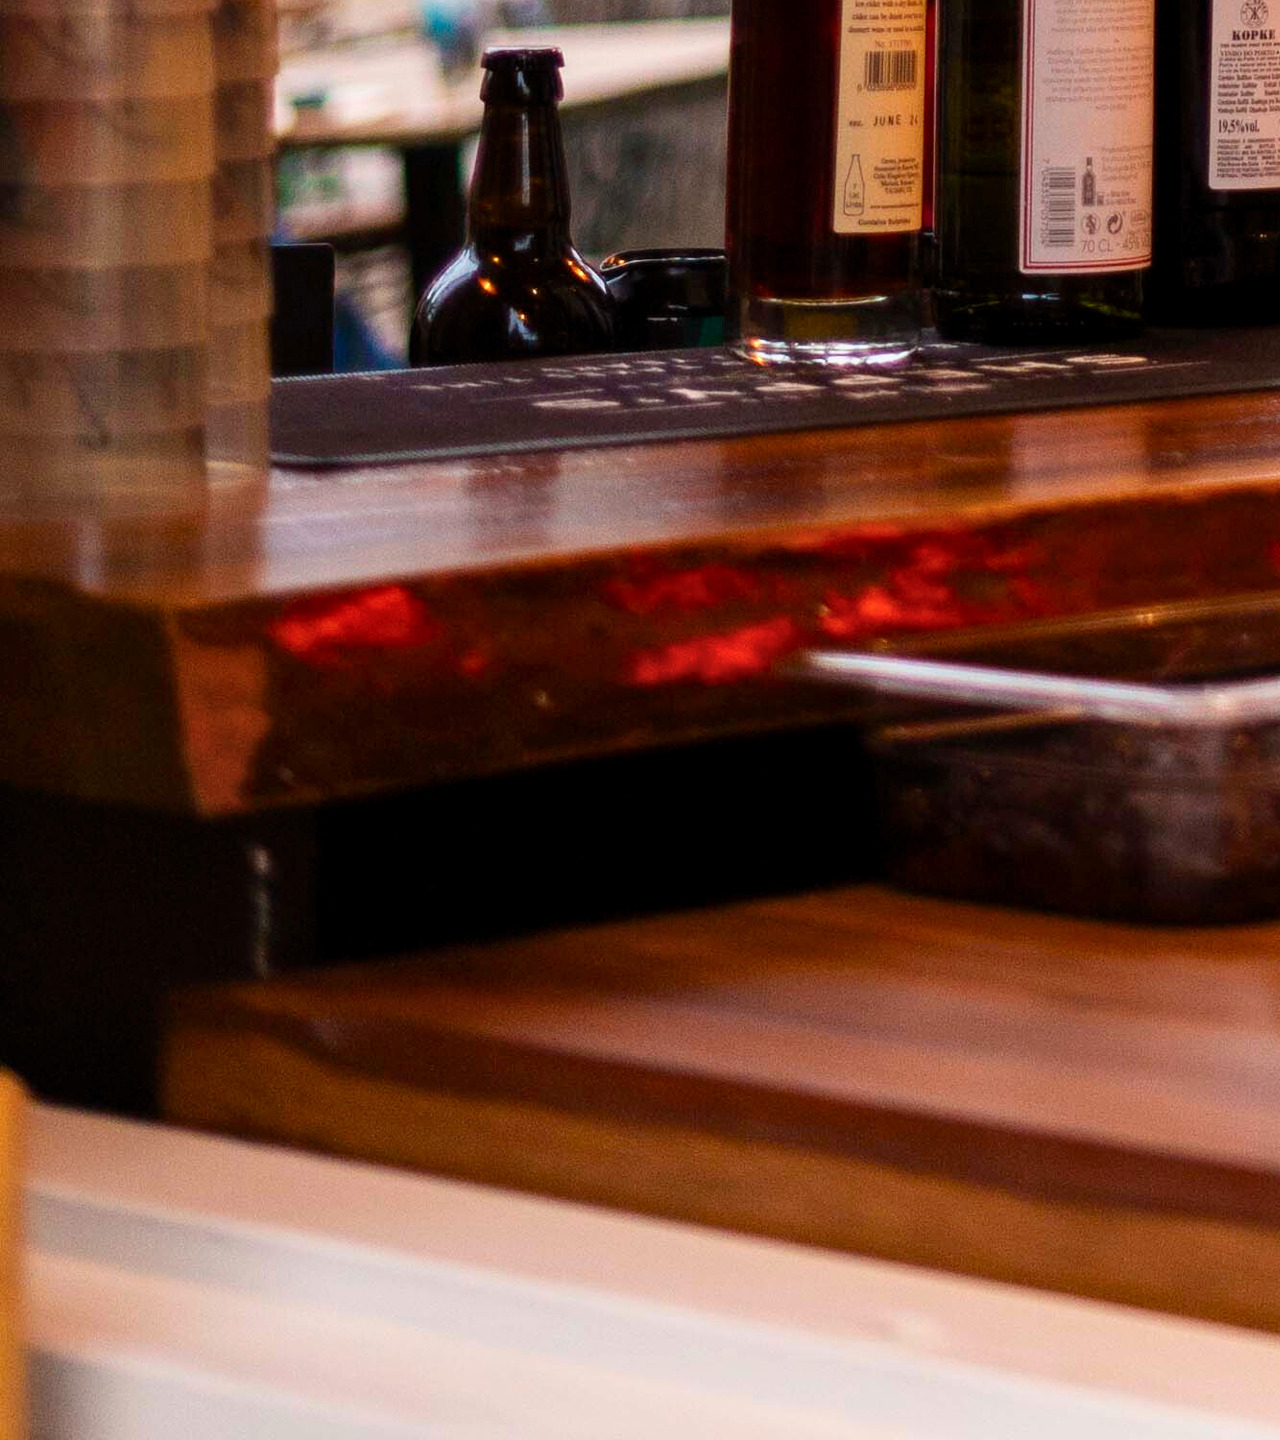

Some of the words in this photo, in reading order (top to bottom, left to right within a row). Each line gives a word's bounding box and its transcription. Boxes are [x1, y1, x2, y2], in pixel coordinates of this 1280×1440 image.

[1232, 29, 1276, 41] KOPKE
[873, 113, 901, 127] JUNE
[1082, 239, 1095, 253] 70
[1098, 238, 1114, 252] CL
